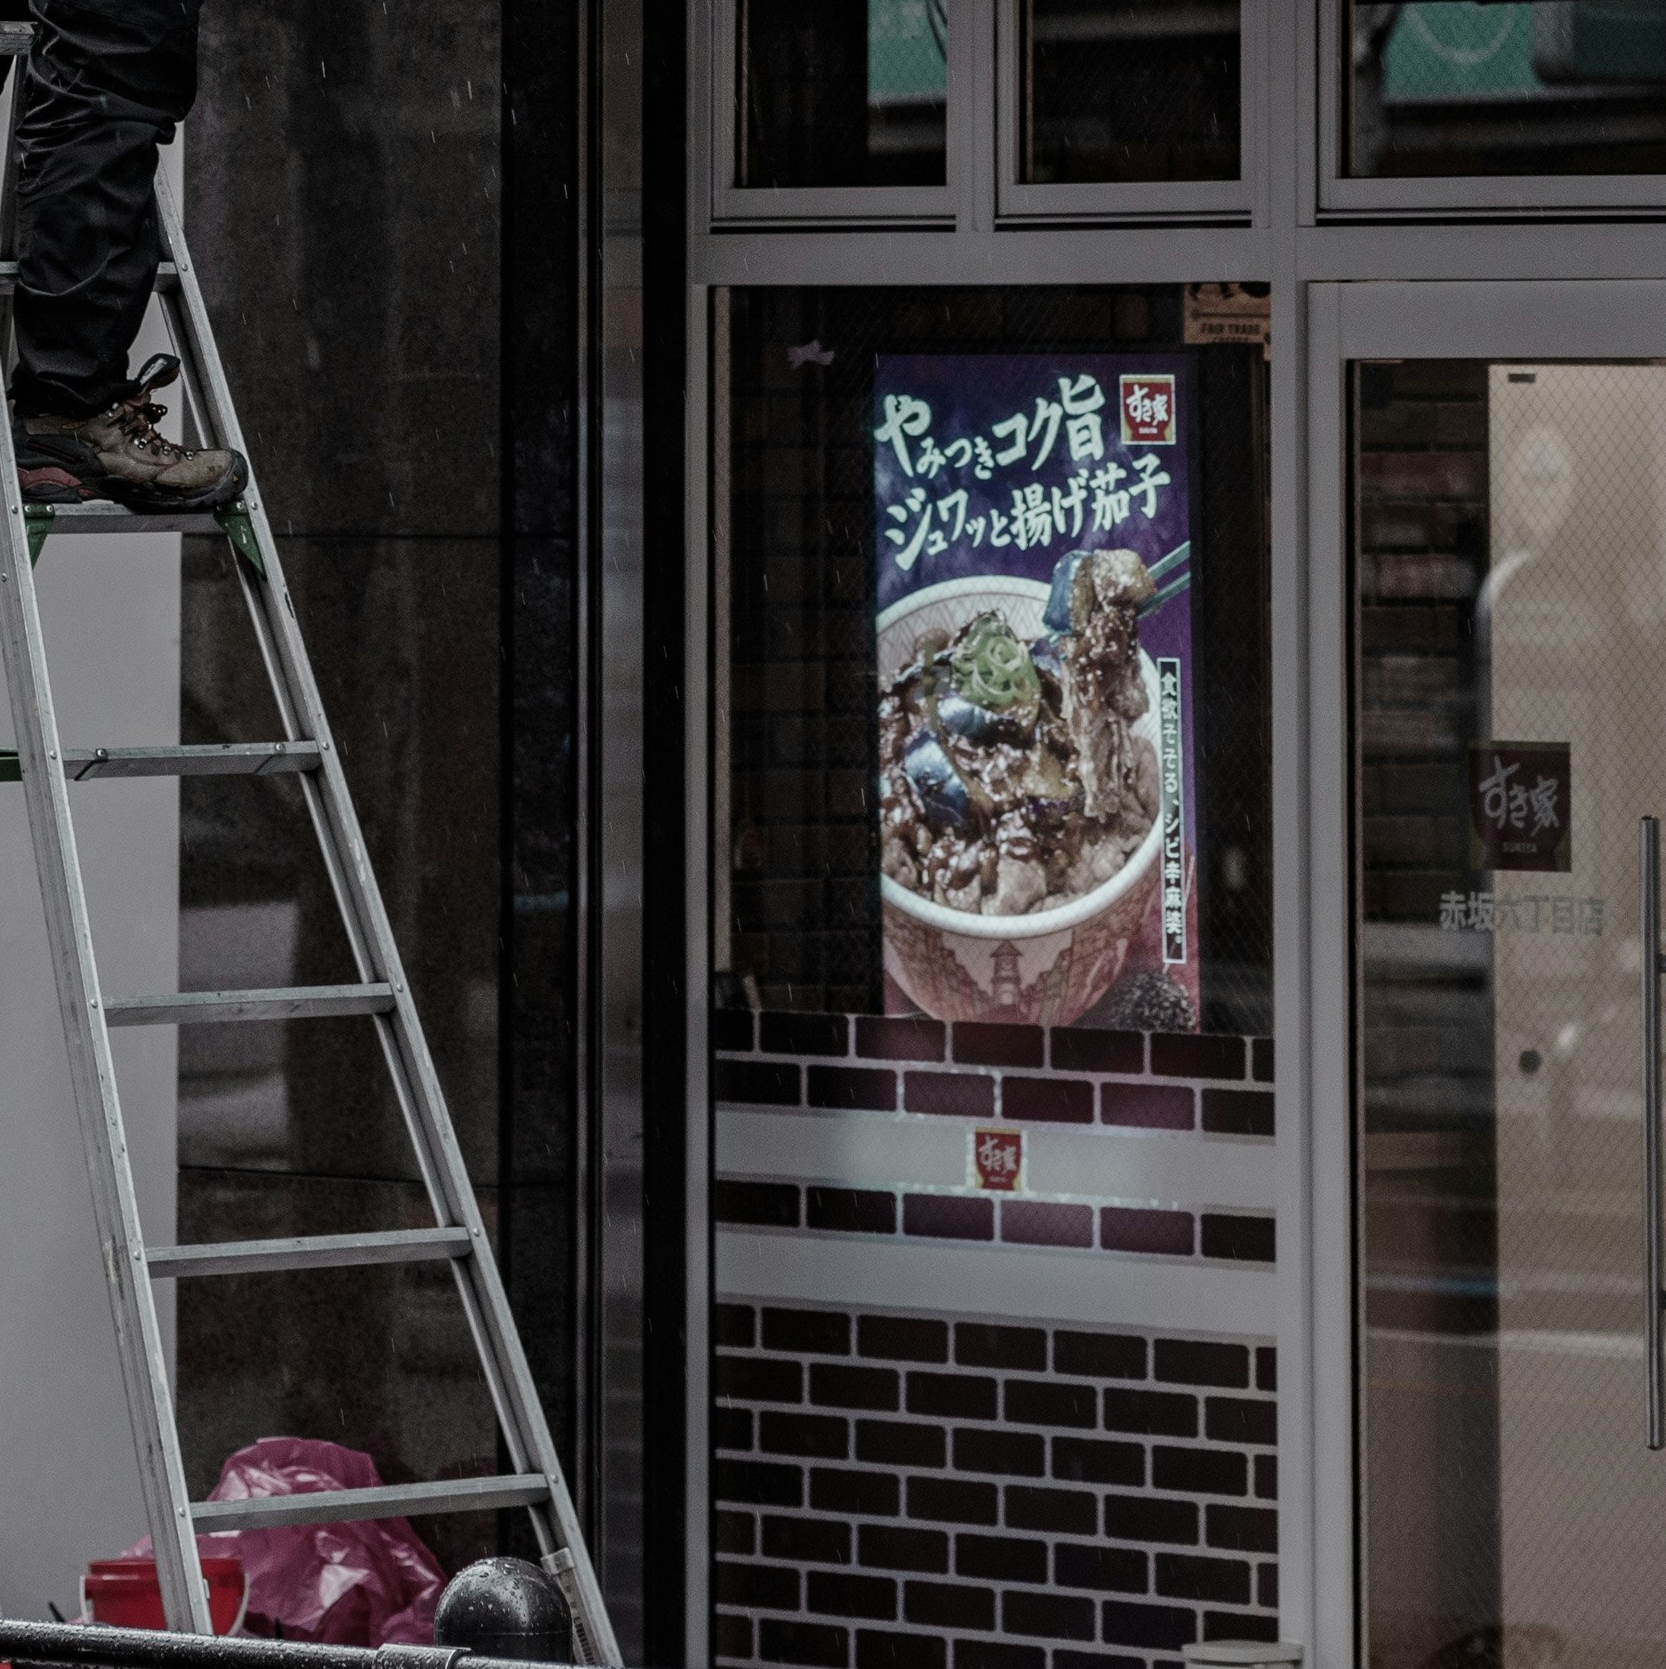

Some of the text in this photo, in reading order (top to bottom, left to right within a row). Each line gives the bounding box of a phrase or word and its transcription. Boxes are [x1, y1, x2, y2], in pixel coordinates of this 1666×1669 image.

[874, 374, 1105, 480] やみつきコク旨
[884, 453, 1171, 571] ジュワッと揚げ茄子
[1478, 755, 1561, 836] すき家
